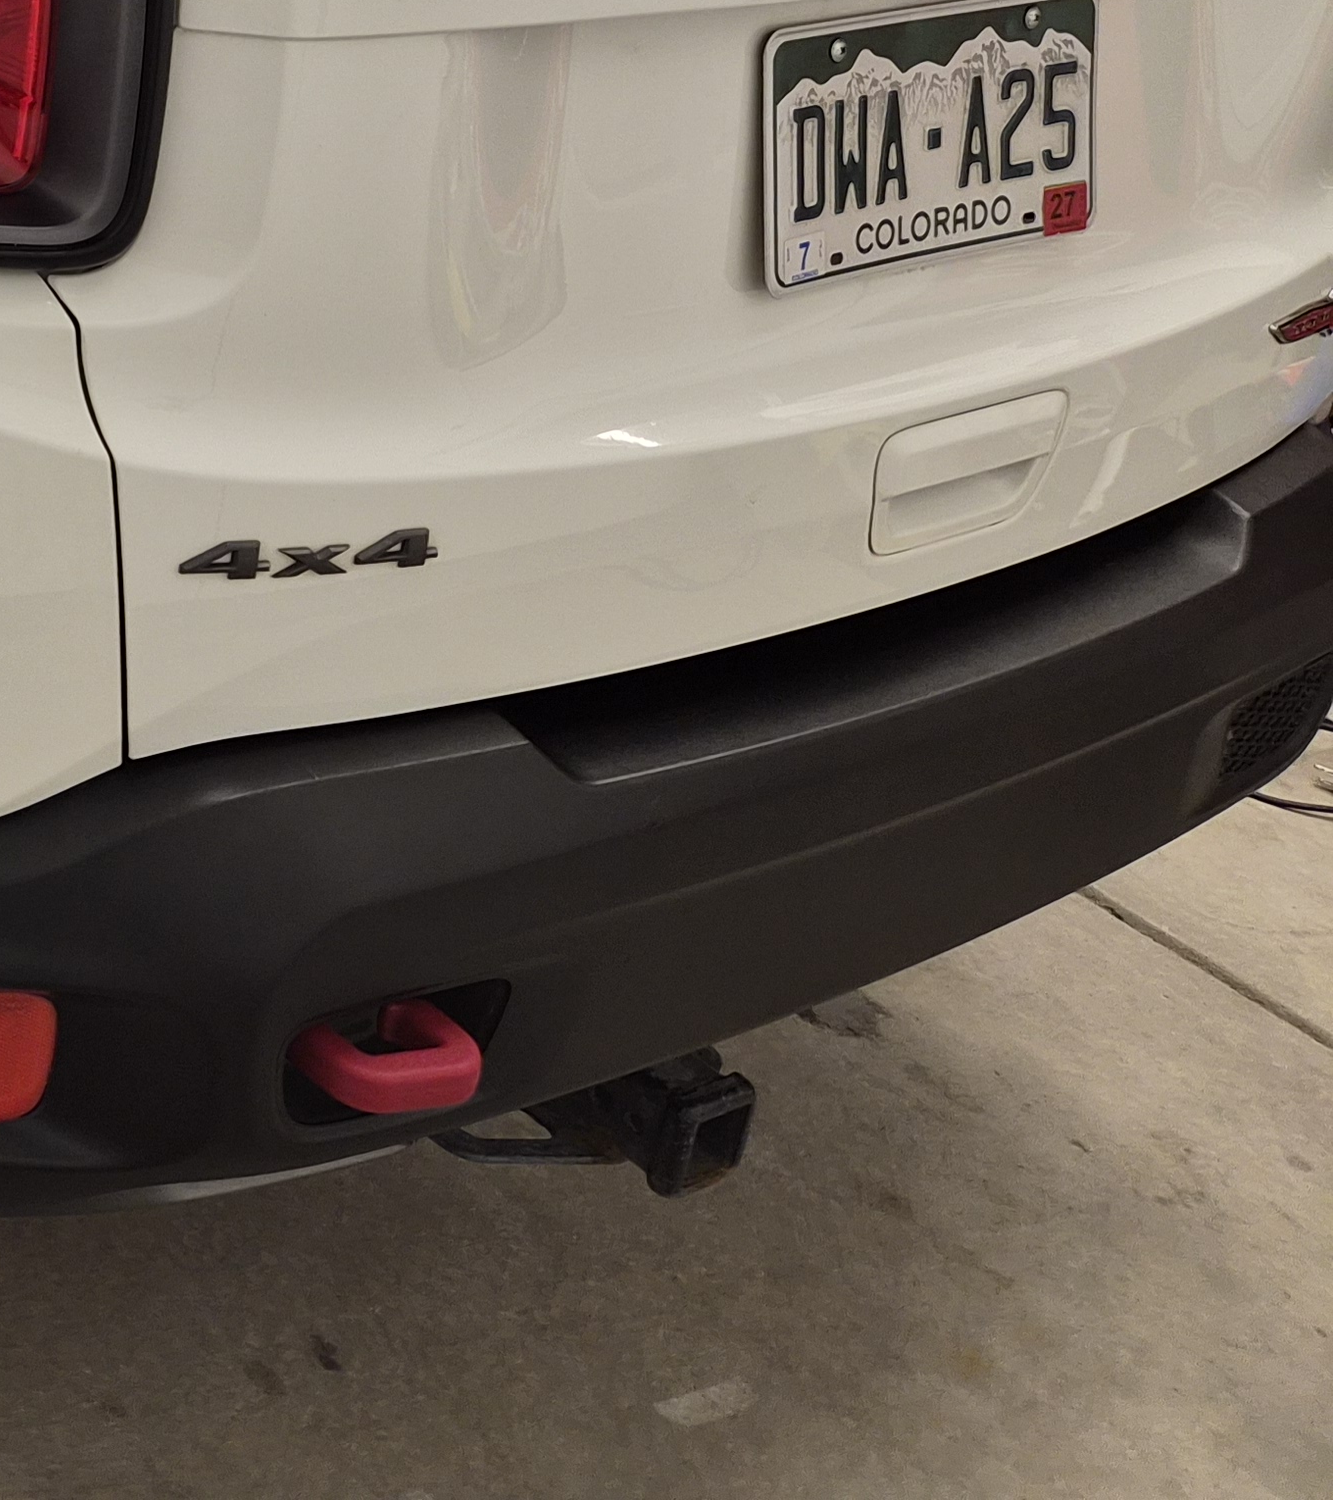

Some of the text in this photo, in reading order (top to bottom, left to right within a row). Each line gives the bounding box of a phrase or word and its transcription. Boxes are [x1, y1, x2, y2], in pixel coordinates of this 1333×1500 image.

[1050, 191, 1076, 219] 27
[855, 195, 1011, 254] COLORADO
[799, 241, 810, 270] 7
